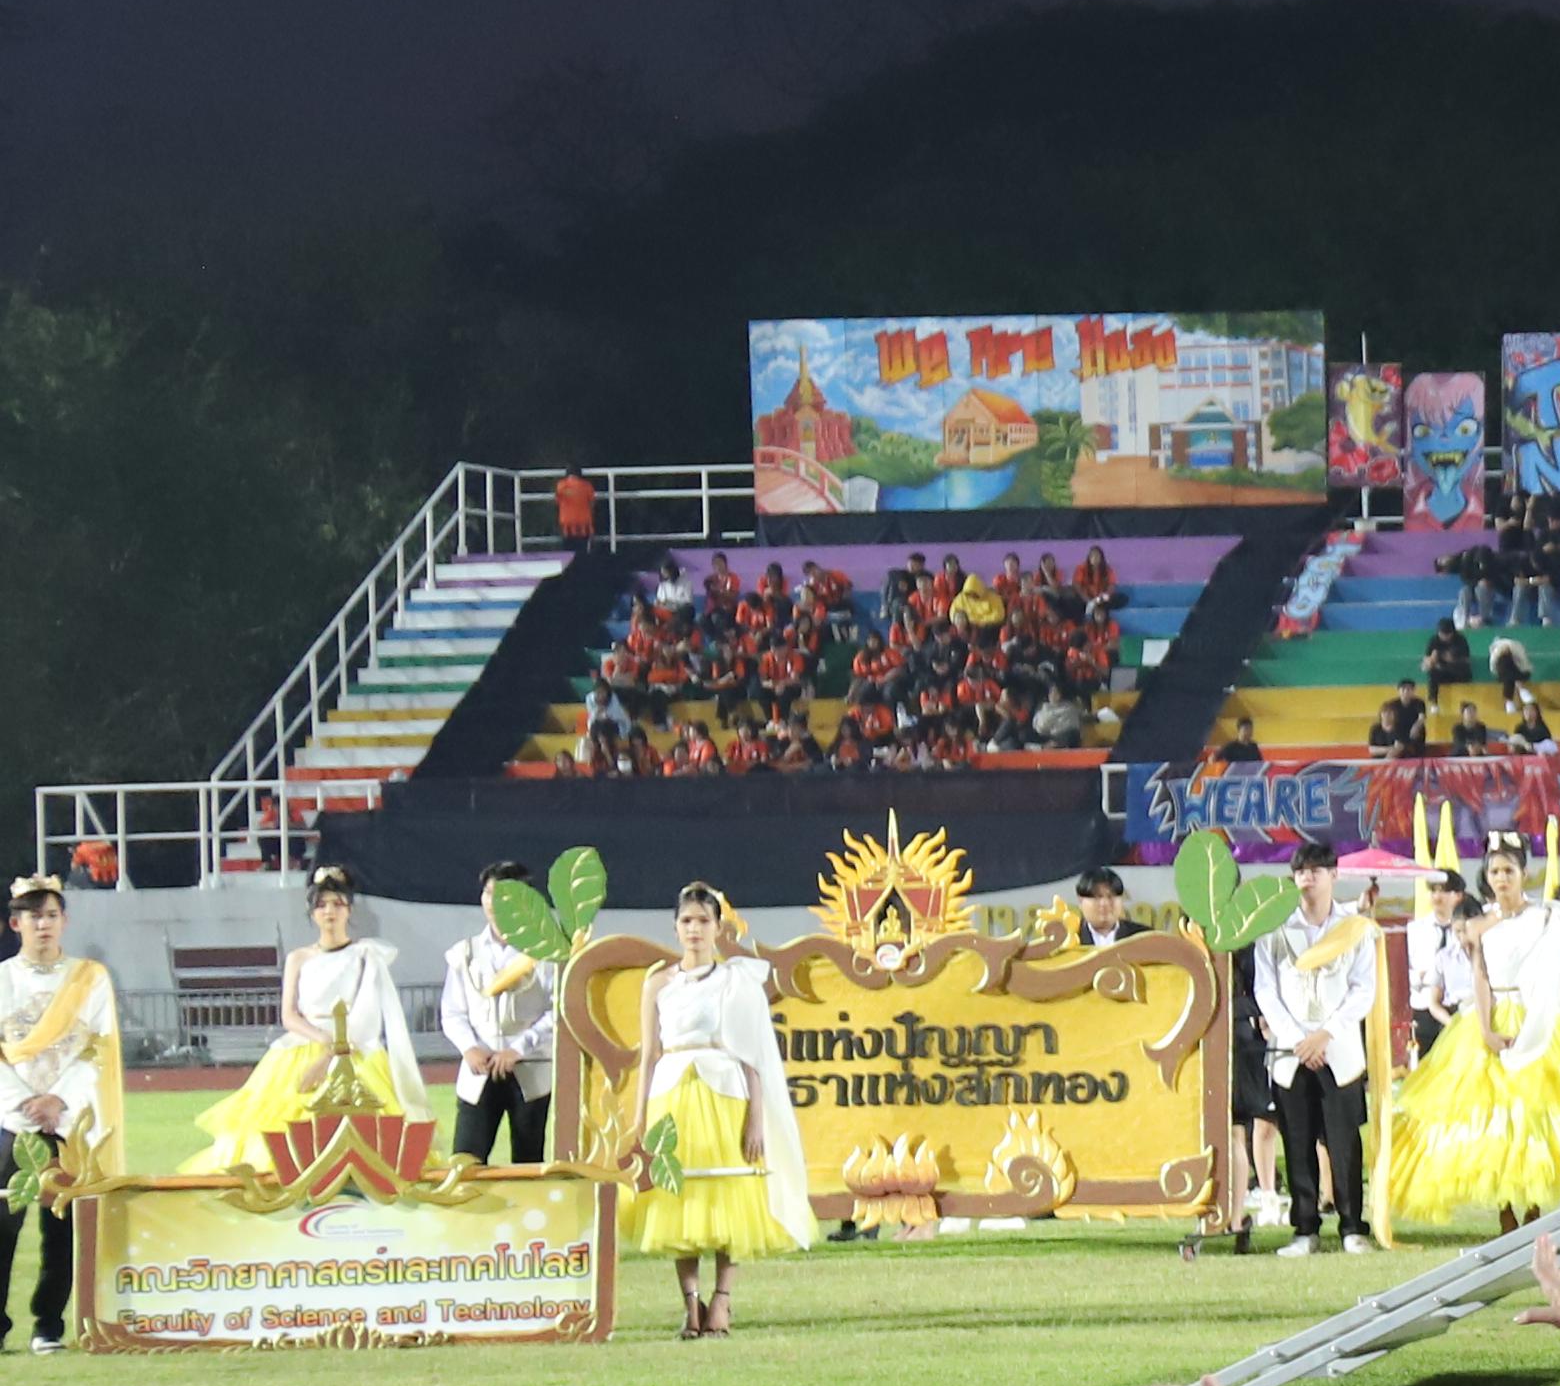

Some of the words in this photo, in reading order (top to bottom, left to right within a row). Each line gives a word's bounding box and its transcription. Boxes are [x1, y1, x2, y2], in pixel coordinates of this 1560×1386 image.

[115, 1242, 591, 1294] คณะวิทยาศาสตร์และเทคโนโลยี
[117, 1309, 216, 1336] Faculty
[224, 1307, 253, 1331] of
[261, 1304, 366, 1330] Science
[376, 1299, 428, 1324] and
